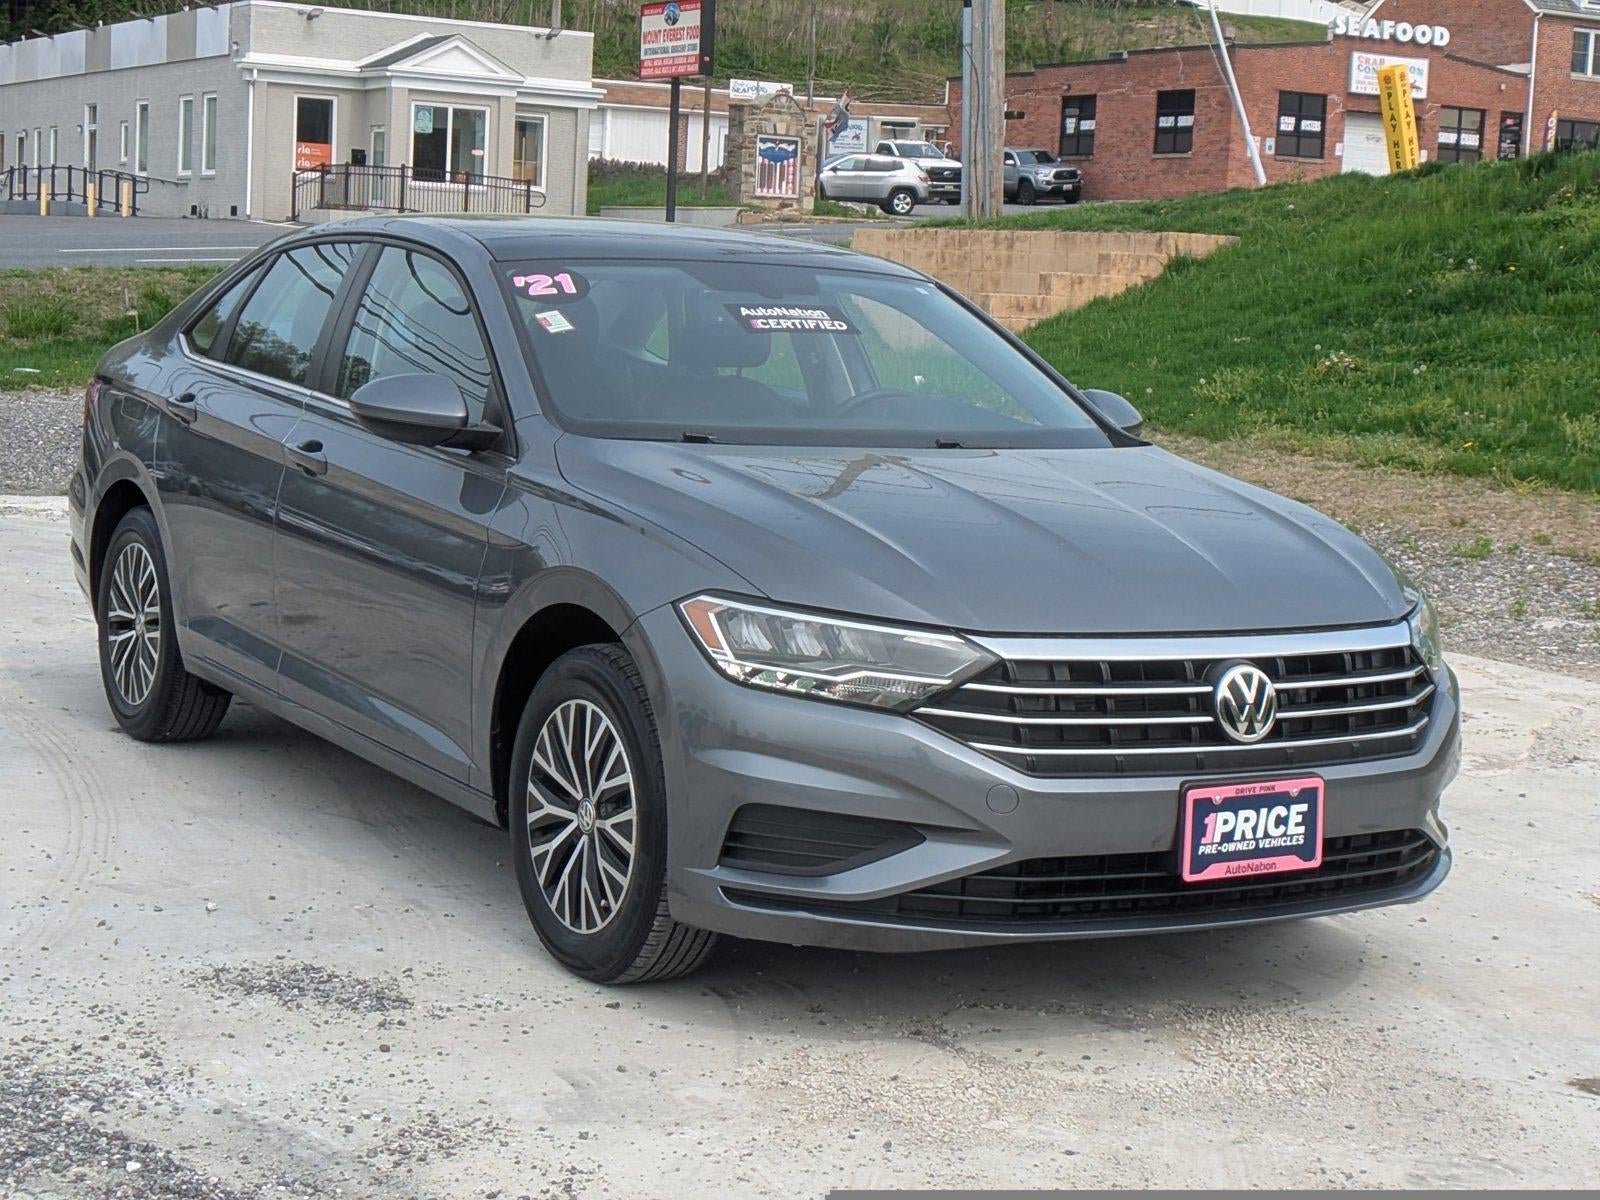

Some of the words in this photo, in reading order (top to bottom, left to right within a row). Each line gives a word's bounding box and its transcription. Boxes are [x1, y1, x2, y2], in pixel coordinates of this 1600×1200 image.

[643, 30, 662, 45] MOUNT
[663, 26, 686, 42] EVEREST
[687, 24, 700, 40] FOOD
[1333, 15, 1450, 47] SEAFOOD
[1387, 92, 1398, 132] PLAY
[1393, 140, 1402, 169] HER
[1402, 89, 1412, 129] PLAY
[1408, 137, 1416, 166] HER
[1547, 117, 1557, 153] OPE
[297, 144, 311, 154] ria
[297, 158, 311, 167] ria
[513, 273, 577, 296] '21
[740, 306, 829, 319] AutoNation
[1235, 787, 1257, 795] DRIVE
[1201, 803, 1309, 844] 1PRICE
[1198, 841, 1256, 856] PRE-OWNED
[1258, 834, 1305, 849] VEHICLES
[1225, 862, 1277, 876] AutoNation
